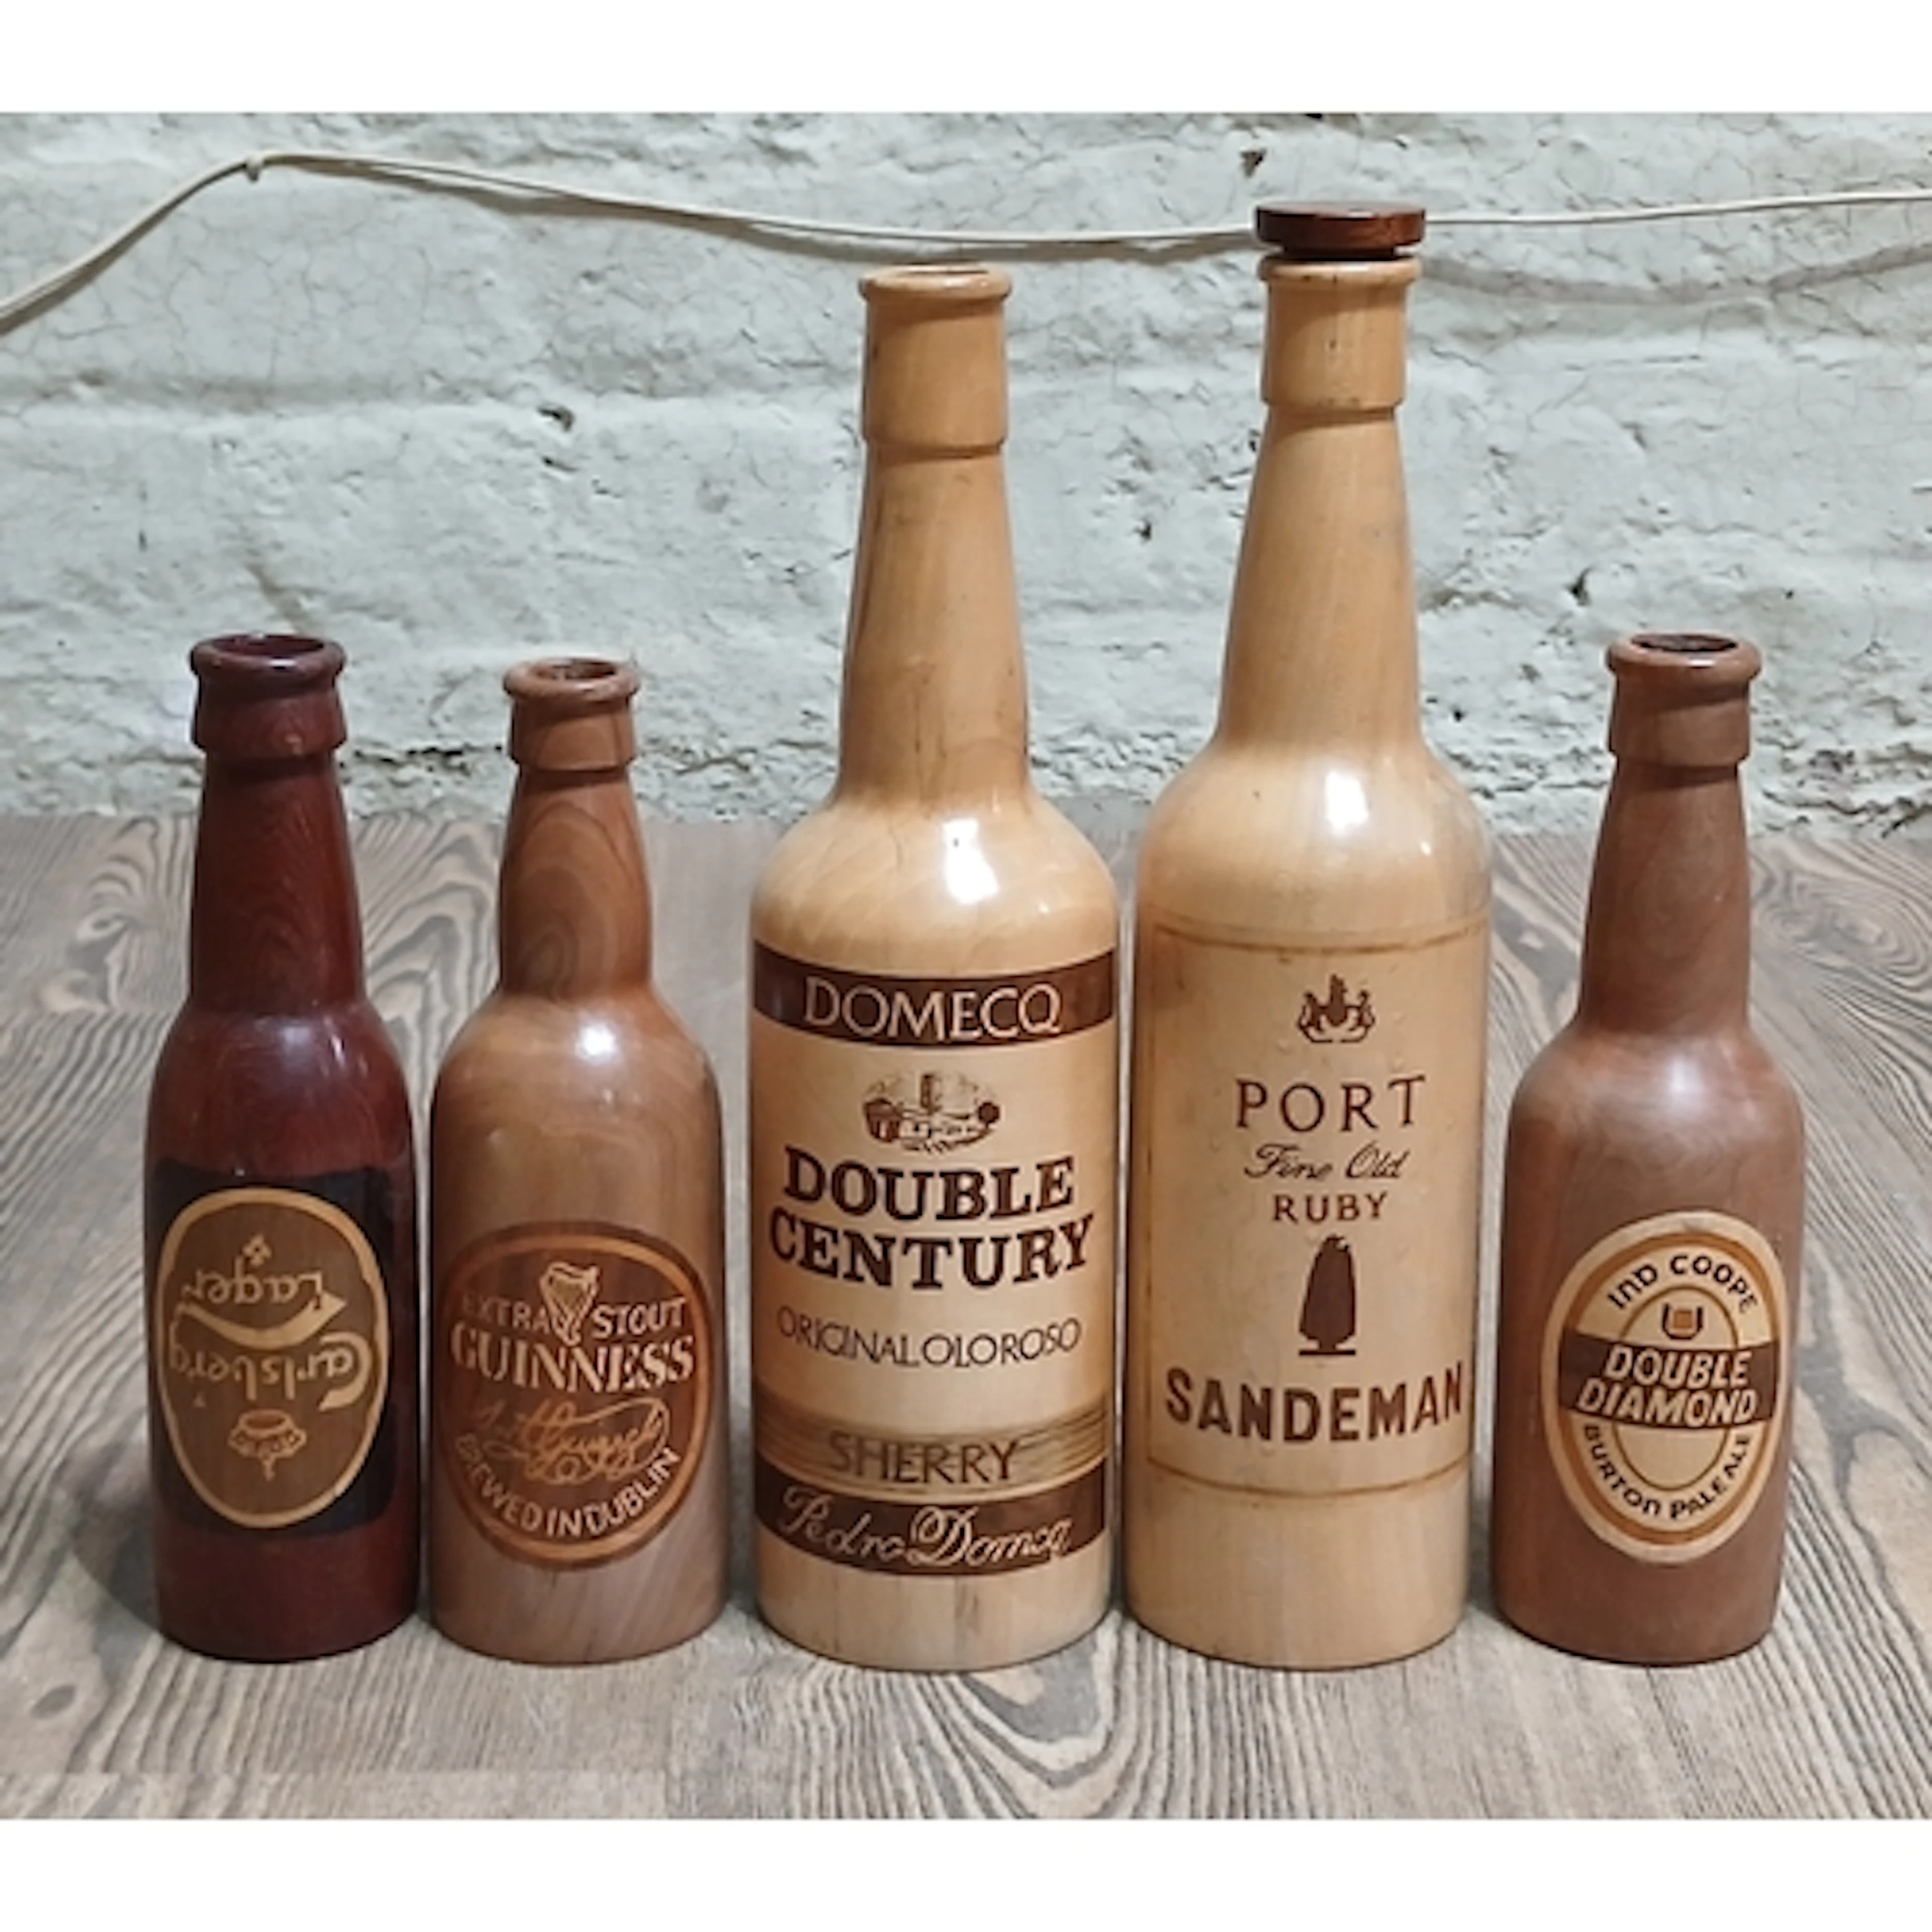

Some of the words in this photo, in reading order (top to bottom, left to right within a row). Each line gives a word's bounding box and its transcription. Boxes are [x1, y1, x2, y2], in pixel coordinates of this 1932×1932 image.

[804, 976, 1061, 1041] DOMECQ
[1235, 1076, 1426, 1133] PORT
[784, 1145, 1074, 1220] DOUBLE
[1245, 1144, 1332, 1181] Fine
[1345, 1141, 1410, 1179] Old
[1273, 1191, 1390, 1224] RUBY
[770, 1206, 1095, 1289] CENTURY
[1607, 1264, 1658, 1309] IND
[1669, 1254, 1758, 1313] COOPE
[462, 1292, 551, 1333] EXTRA
[592, 1297, 687, 1339] STOUT
[921, 1318, 1081, 1367] OLOROSO
[170, 1316, 371, 1410] Carlsberg
[452, 1323, 694, 1393] GUINNESS
[1604, 1346, 1752, 1389] DOUBLE
[1165, 1360, 1463, 1442] SANDEMAN
[1577, 1378, 1758, 1427] DIAMOND
[829, 1430, 1017, 1483] SHERRY
[1584, 1424, 1660, 1515] BURTON
[1670, 1480, 1727, 1519] PALE
[547, 1509, 582, 1537] IN
[586, 1447, 681, 1535] DUBLIN
[781, 1484, 906, 1558] Pedro
